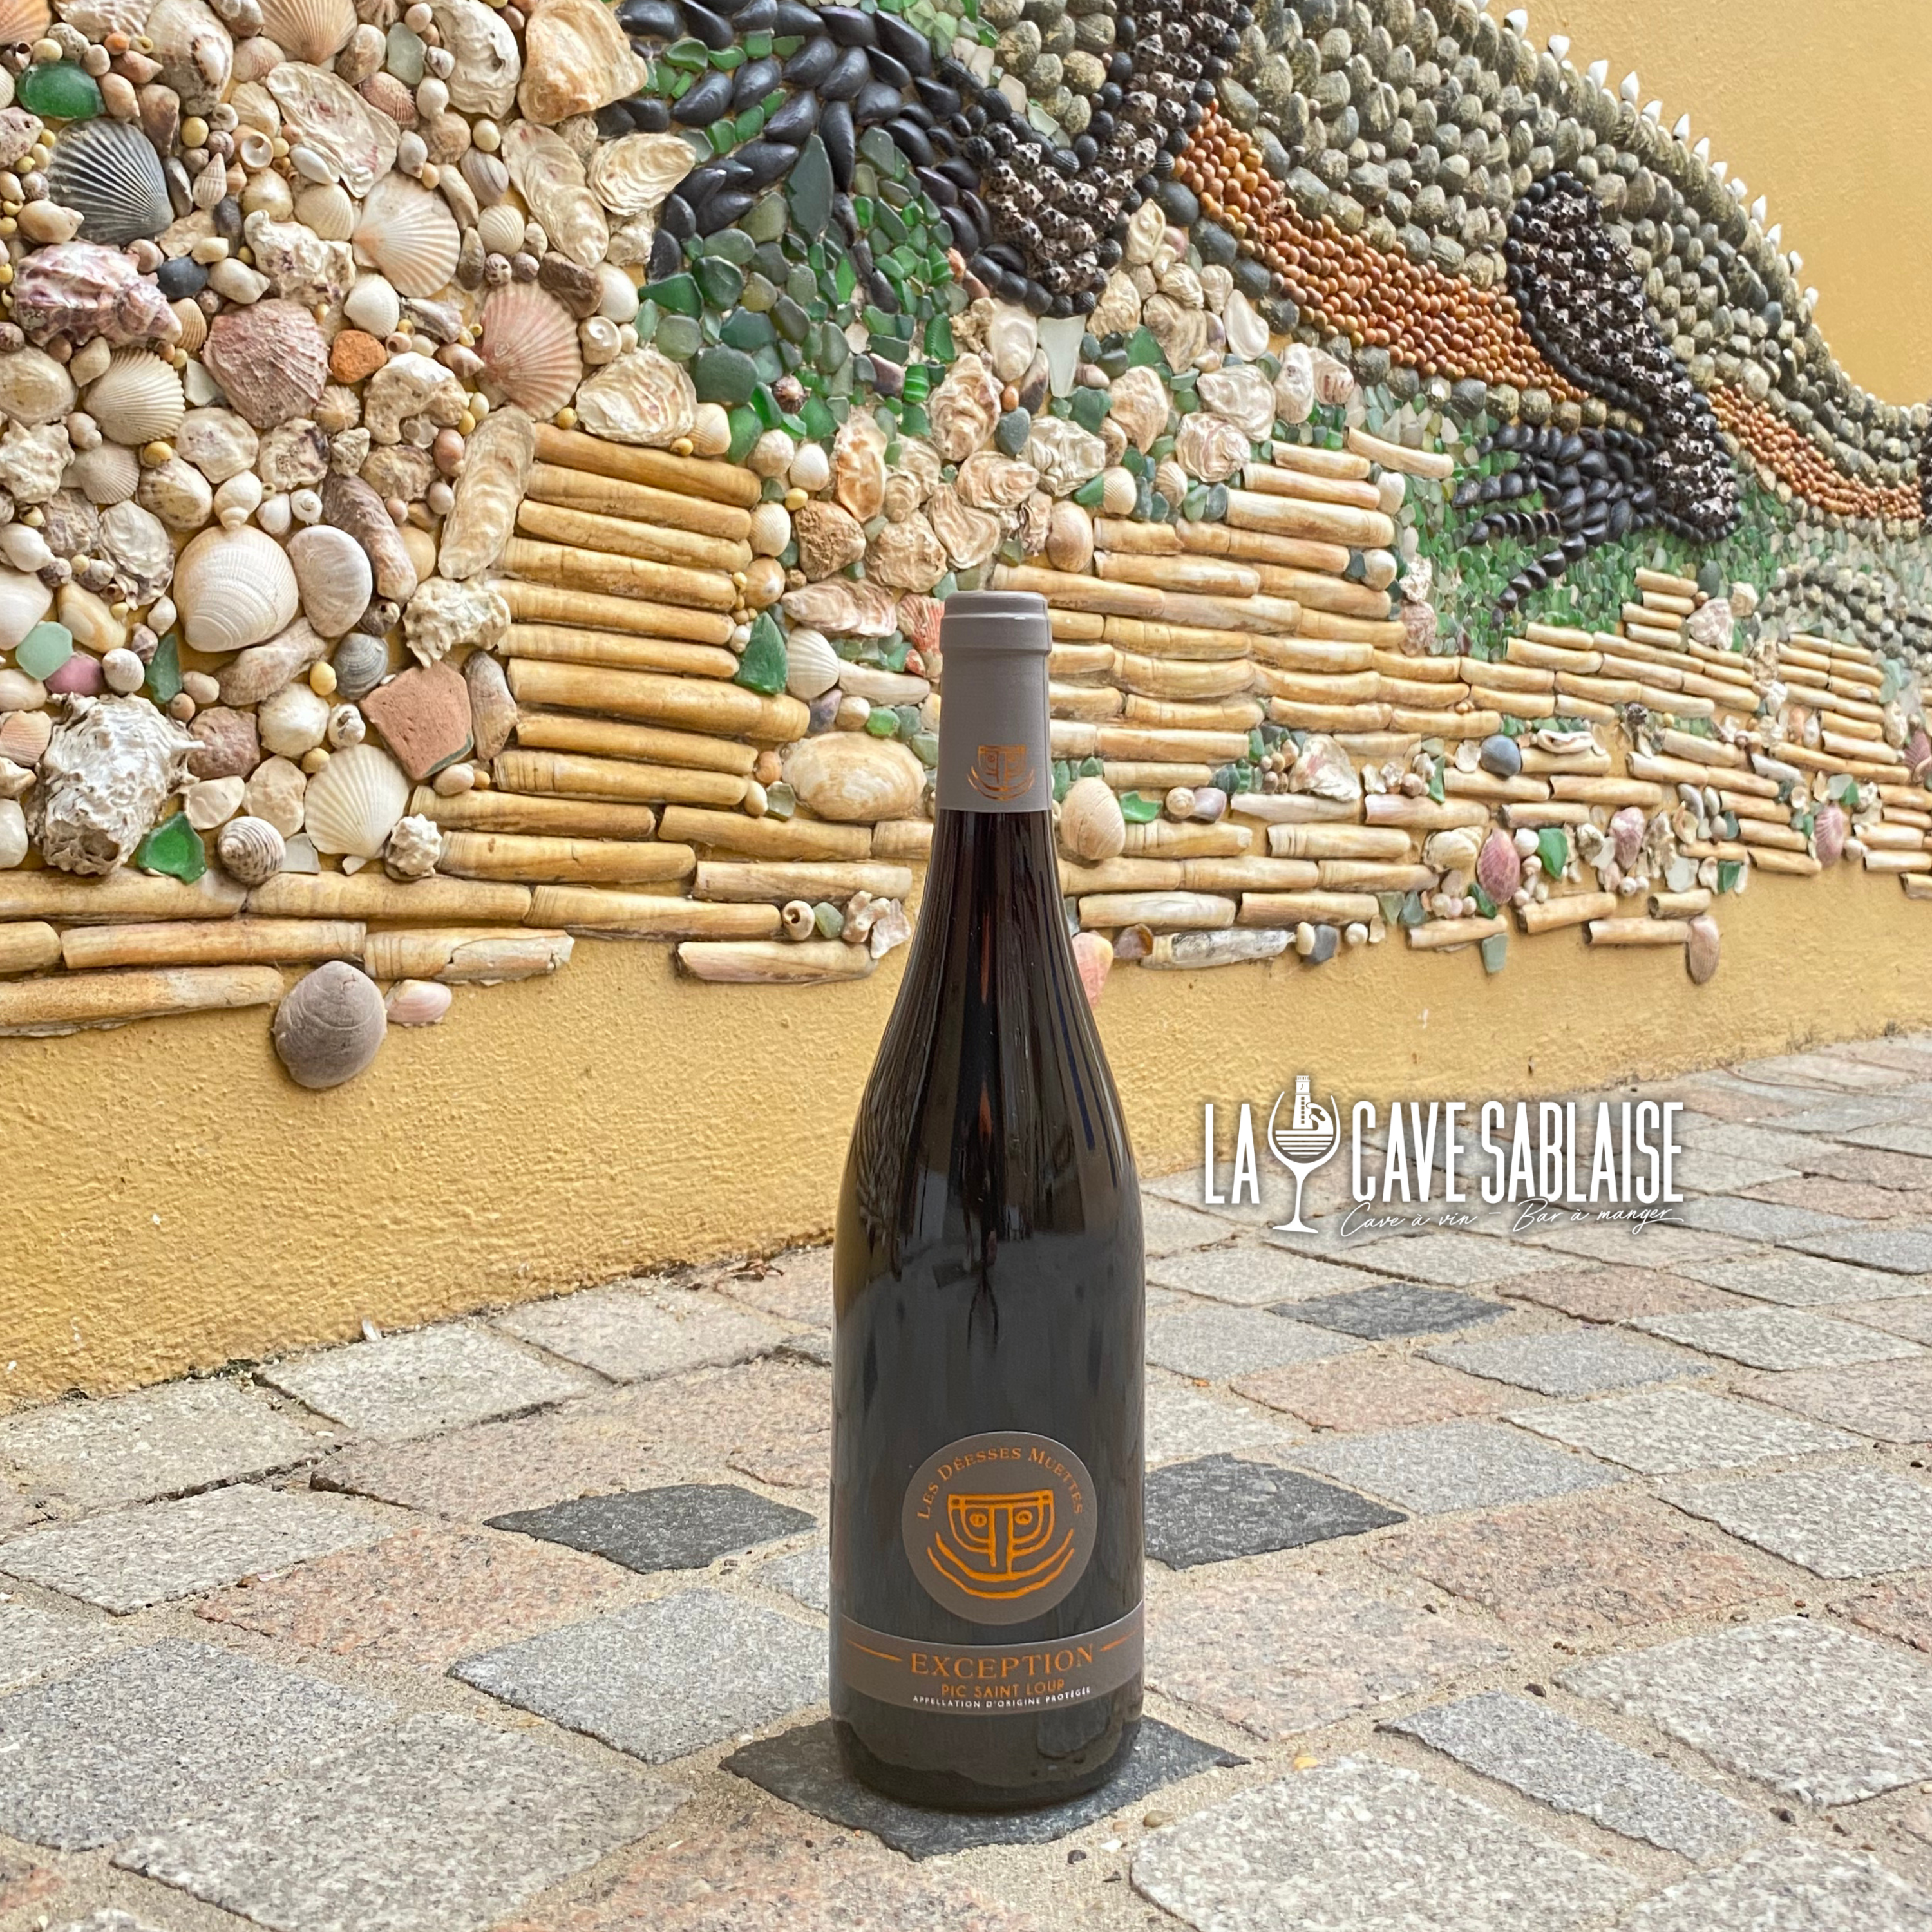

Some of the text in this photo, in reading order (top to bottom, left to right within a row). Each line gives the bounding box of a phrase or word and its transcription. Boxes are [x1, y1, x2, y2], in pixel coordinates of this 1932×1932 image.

[917, 1482, 940, 1520] LES
[1028, 1447, 1083, 1515] MUETTES
[911, 1643, 1094, 1680] EXCEPTION
[913, 1694, 981, 1709] APPELLATION
[986, 1698, 1041, 1708] D'ORIGINE
[941, 1679, 1065, 1699] PIC SAINT LOUP
